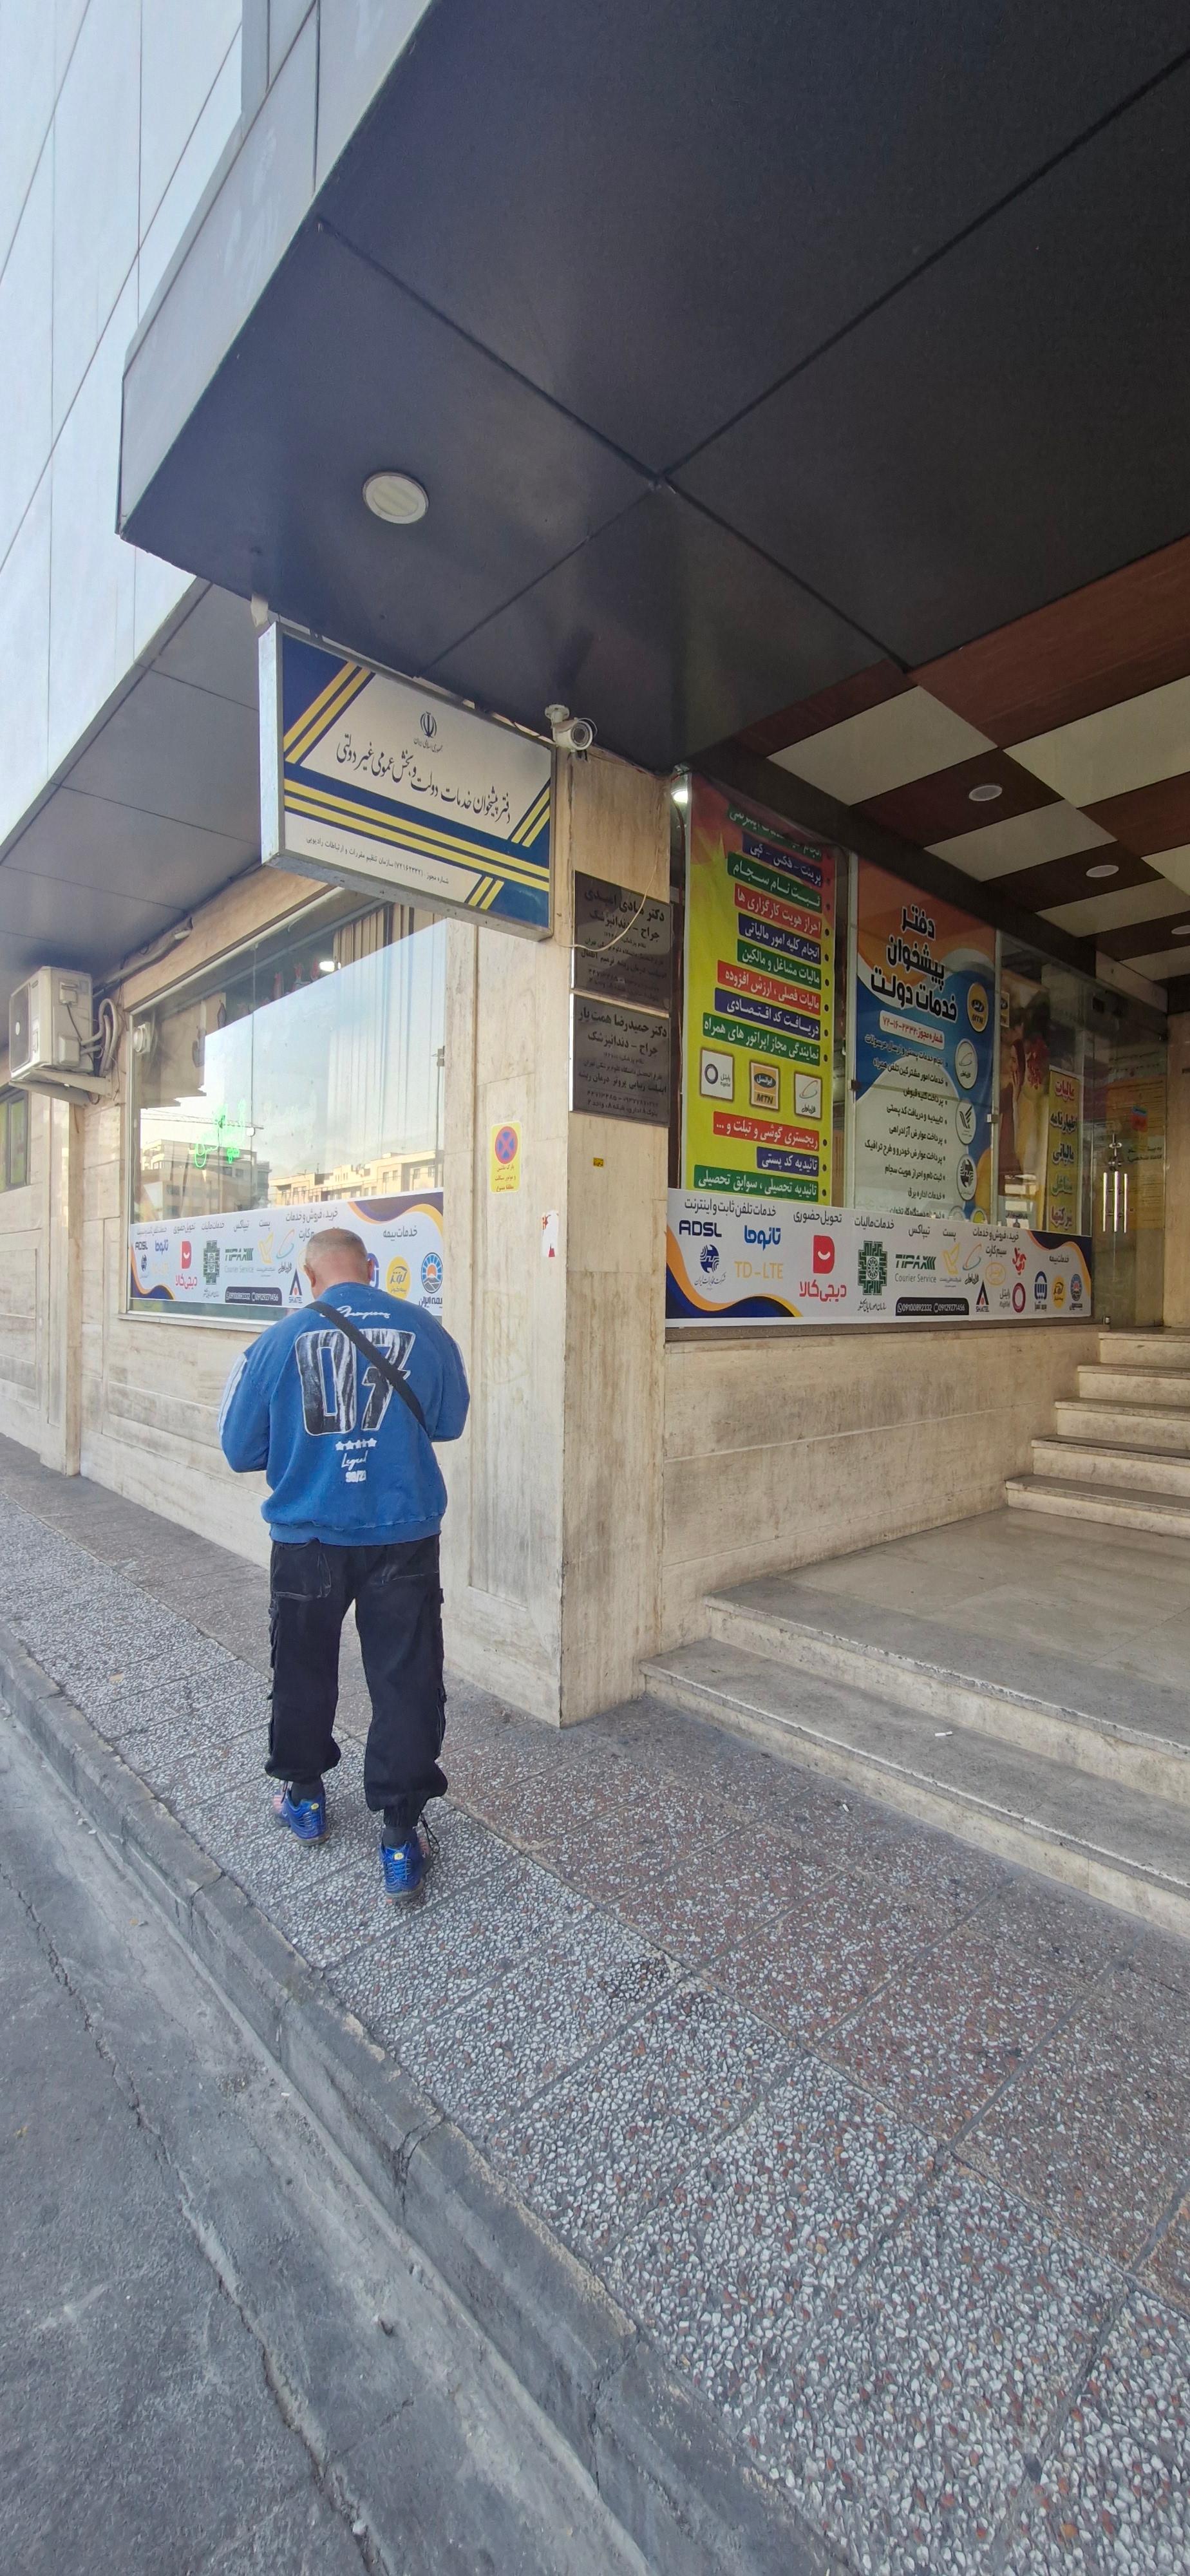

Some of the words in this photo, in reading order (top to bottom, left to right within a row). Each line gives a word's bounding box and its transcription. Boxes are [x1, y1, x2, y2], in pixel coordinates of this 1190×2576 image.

[336, 734, 357, 763] دولتی
[353, 741, 374, 771] غیر
[372, 752, 394, 777] عمومی
[392, 749, 413, 783] بخش
[411, 770, 439, 797] دولت
[440, 788, 471, 810] خدمات
[473, 786, 498, 817] پیشخوان
[495, 792, 511, 824] دفتر
[750, 844, 763, 858] کپی
[773, 855, 793, 869] فکس
[733, 860, 770, 885] سجام
[800, 866, 822, 887] پرینت
[770, 877, 791, 894] نام
[737, 888, 746, 902] ها
[791, 887, 821, 907] ثبت
[647, 909, 665, 922] دکتر
[782, 910, 802, 928] هویت
[902, 904, 936, 941] دفتر
[744, 922, 770, 940] مالیاتی
[804, 916, 821, 934] احراز
[641, 927, 660, 942] جراح
[771, 934, 785, 947] امور
[786, 937, 801, 951] کلیه
[801, 942, 820, 960] انجام
[742, 949, 766, 964] مالکین
[887, 934, 946, 992] پیشخوان
[768, 960, 771, 971] و
[773, 958, 797, 976] مشاغل
[725, 970, 749, 989] افزوده
[798, 968, 820, 984] مالیات
[751, 976, 772, 997] ارزش
[778, 986, 798, 1002] فصلی
[870, 966, 913, 1010] دولت
[726, 998, 772, 1019] اقتصادی
[799, 994, 820, 1010] مالیات
[915, 983, 958, 1023] خدمات
[614, 1014, 649, 1034] حمیدرضا
[773, 1011, 782, 1023] کد
[650, 1025, 667, 1038] دکتر
[704, 1017, 726, 1036] همراه
[727, 1025, 744, 1041] های
[783, 1016, 819, 1037] دریافت
[588, 1031, 629, 1048] دندانپزشک
[745, 1031, 770, 1051] اپراتور
[770, 1036, 787, 1054] مجاز
[639, 1043, 658, 1057] جراح
[788, 1042, 819, 1061] نمایندگی
[899, 1066, 920, 1078] مشترکین
[930, 1073, 944, 1084] خدمات
[1055, 1080, 1075, 1101] مالیات
[756, 1094, 774, 1104] MTN
[927, 1094, 944, 1108] پرداخت
[887, 1104, 902, 1117] پستی
[901, 1106, 907, 1115] کد
[907, 1108, 924, 1120] دریافت
[726, 1122, 731, 1135] و
[733, 1120, 752, 1137] تبلت
[753, 1128, 759, 1139] و
[759, 1124, 784, 1142] گوشی
[911, 1129, 927, 1141] عوارض
[784, 1131, 818, 1150] ریجستری
[864, 1139, 883, 1152] ترافیک
[927, 1133, 943, 1146] پرداخت
[896, 1146, 910, 1157] خودرو
[910, 1149, 926, 1160] عوارض
[926, 1152, 943, 1165] پرداخت
[1053, 1143, 1074, 1166] مالیاتی
[761, 1153, 782, 1170] پستی
[784, 1155, 794, 1167] کد
[884, 1164, 898, 1175] سجام
[898, 1167, 911, 1178] هویت
[911, 1169, 923, 1179] احراز
[933, 1172, 942, 1182] ثبت
[698, 1170, 732, 1187] تحصیلی
[733, 1175, 758, 1192] سوابق
[764, 1179, 793, 1195] تحصیلی
[907, 1187, 916, 1198] برق
[916, 1190, 927, 1199] اداره
[927, 1191, 942, 1200] خدمات
[684, 1198, 712, 1215] اینترنت
[712, 1204, 717, 1215] و
[717, 1200, 735, 1217] ثابت
[735, 1201, 753, 1218] تلفن
[753, 1203, 777, 1217] خدمات
[285, 1209, 302, 1222] خدمات
[302, 1212, 306, 1224] و
[306, 1209, 322, 1224] فروش
[793, 1209, 820, 1224] حضوری
[820, 1210, 842, 1226] تحویل
[854, 1215, 874, 1230] مالیات
[874, 1217, 894, 1229] خدمات
[259, 1218, 270, 1231] پست
[397, 1224, 418, 1238] خدمات
[679, 1220, 722, 1238] ADSL
[972, 1227, 989, 1237] خدمات
[298, 1227, 310, 1242] کارت
[382, 1228, 397, 1242] بیمه
[942, 1228, 956, 1242] پست
[992, 1229, 1006, 1242] فروش
[135, 1241, 148, 1251] ADSL
[985, 1244, 996, 1257] کارت
[996, 1247, 1007, 1258] سیم
[225, 1247, 254, 1262] TIPAX
[895, 1254, 936, 1270] TIPAX
[894, 1273, 916, 1282] Courier
[917, 1273, 937, 1283] Service
[419, 1296, 431, 1308] ایران
[295, 1328, 416, 1436] 07
[341, 1450, 368, 1471] Legend
